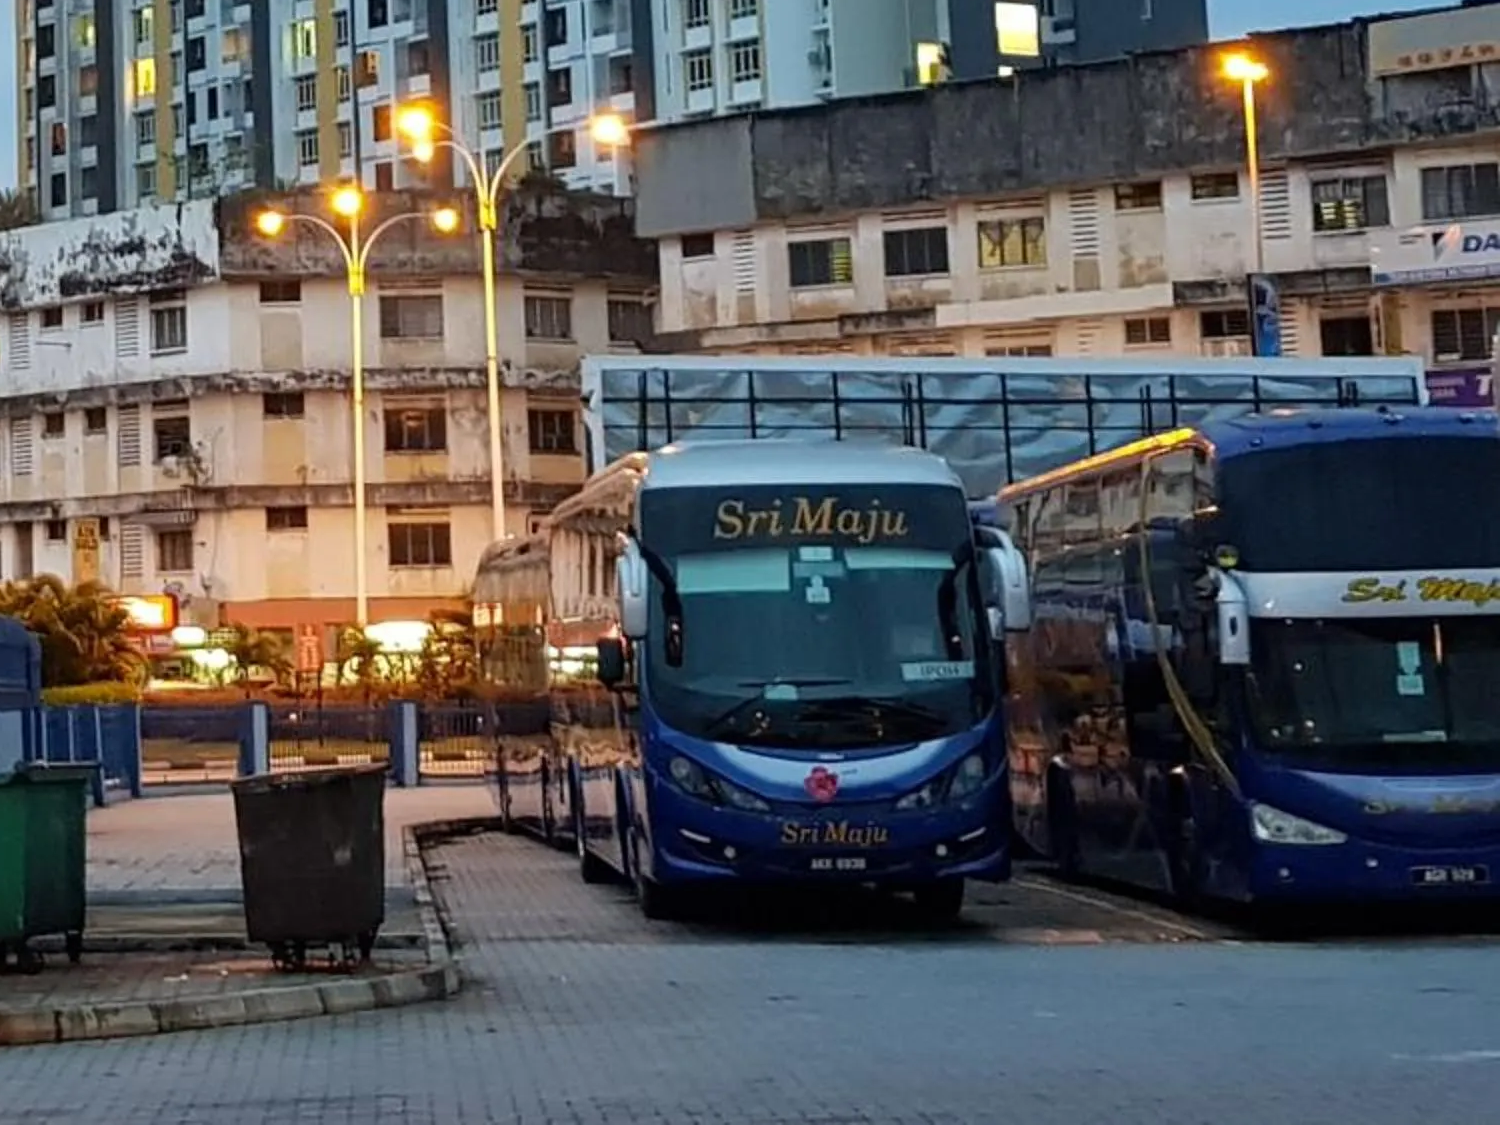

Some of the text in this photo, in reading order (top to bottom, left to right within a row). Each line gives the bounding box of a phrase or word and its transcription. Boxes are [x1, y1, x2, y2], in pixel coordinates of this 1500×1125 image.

[713, 496, 909, 544] Sri Maju
[1341, 576, 1500, 608] Sri Maj
[781, 819, 889, 847] Sri Maju
